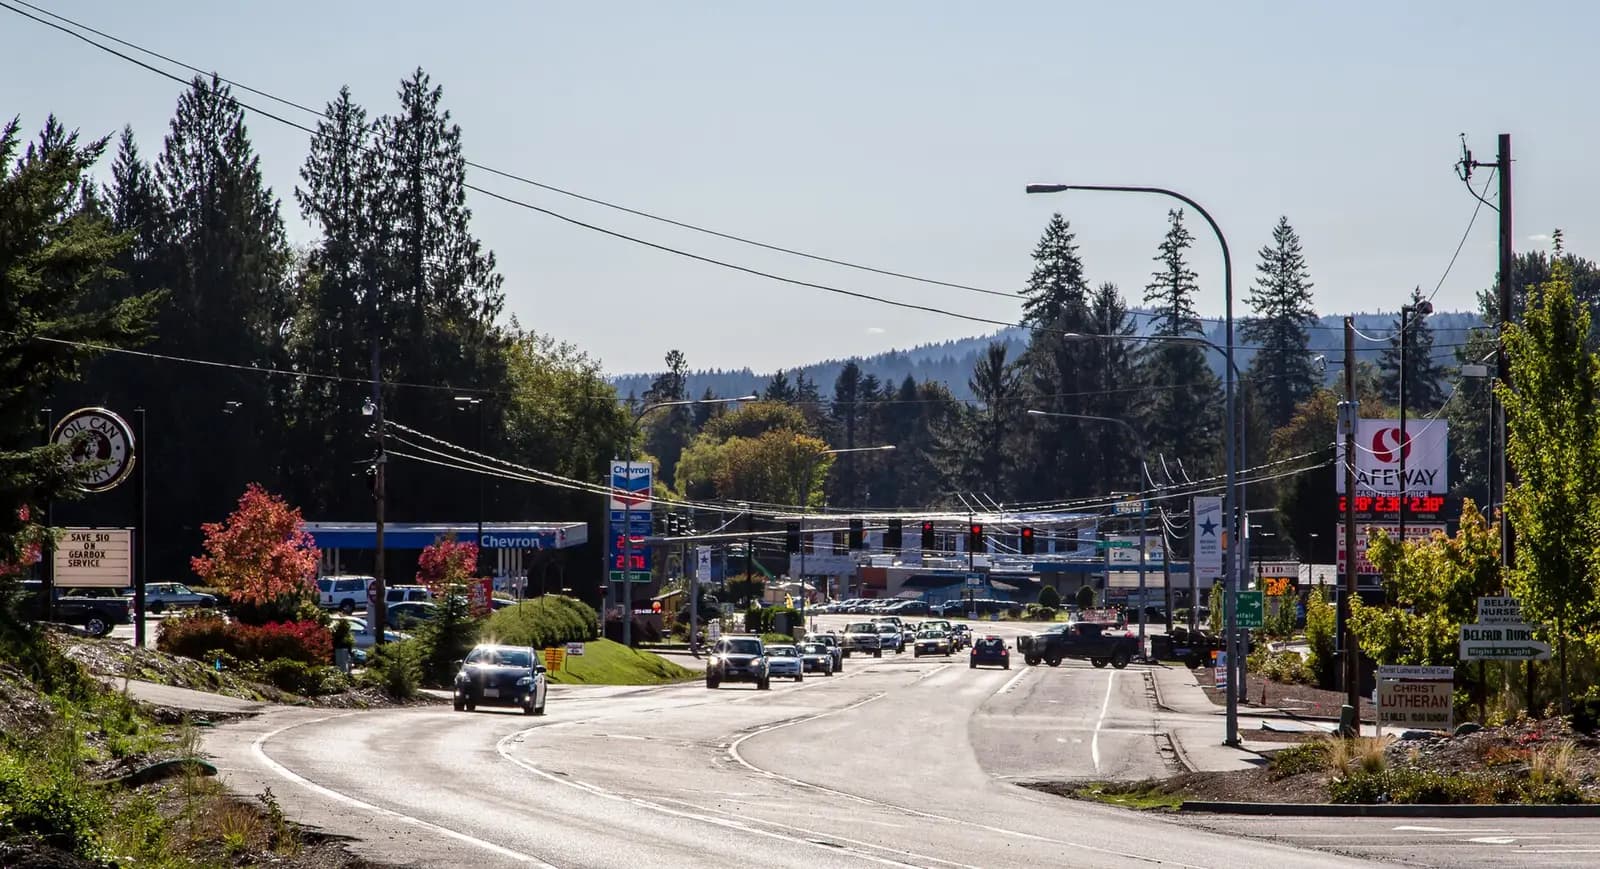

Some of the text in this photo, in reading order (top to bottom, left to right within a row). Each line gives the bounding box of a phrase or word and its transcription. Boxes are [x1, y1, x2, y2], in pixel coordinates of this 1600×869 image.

[64, 417, 119, 439] OIL CAN
[1354, 468, 1438, 486] AFEWAY
[71, 533, 92, 542] SAVE
[481, 536, 540, 549] Chevron
[68, 551, 106, 559] GEARBOX
[68, 560, 101, 568] SERVICE
[1484, 599, 1520, 607] BELFAI
[1506, 629, 1532, 641] NURS
[1469, 647, 1493, 657] Right
[1507, 647, 1531, 657] Light
[1393, 684, 1437, 693] CHRIST
[1381, 694, 1448, 708] LUTHERAN
